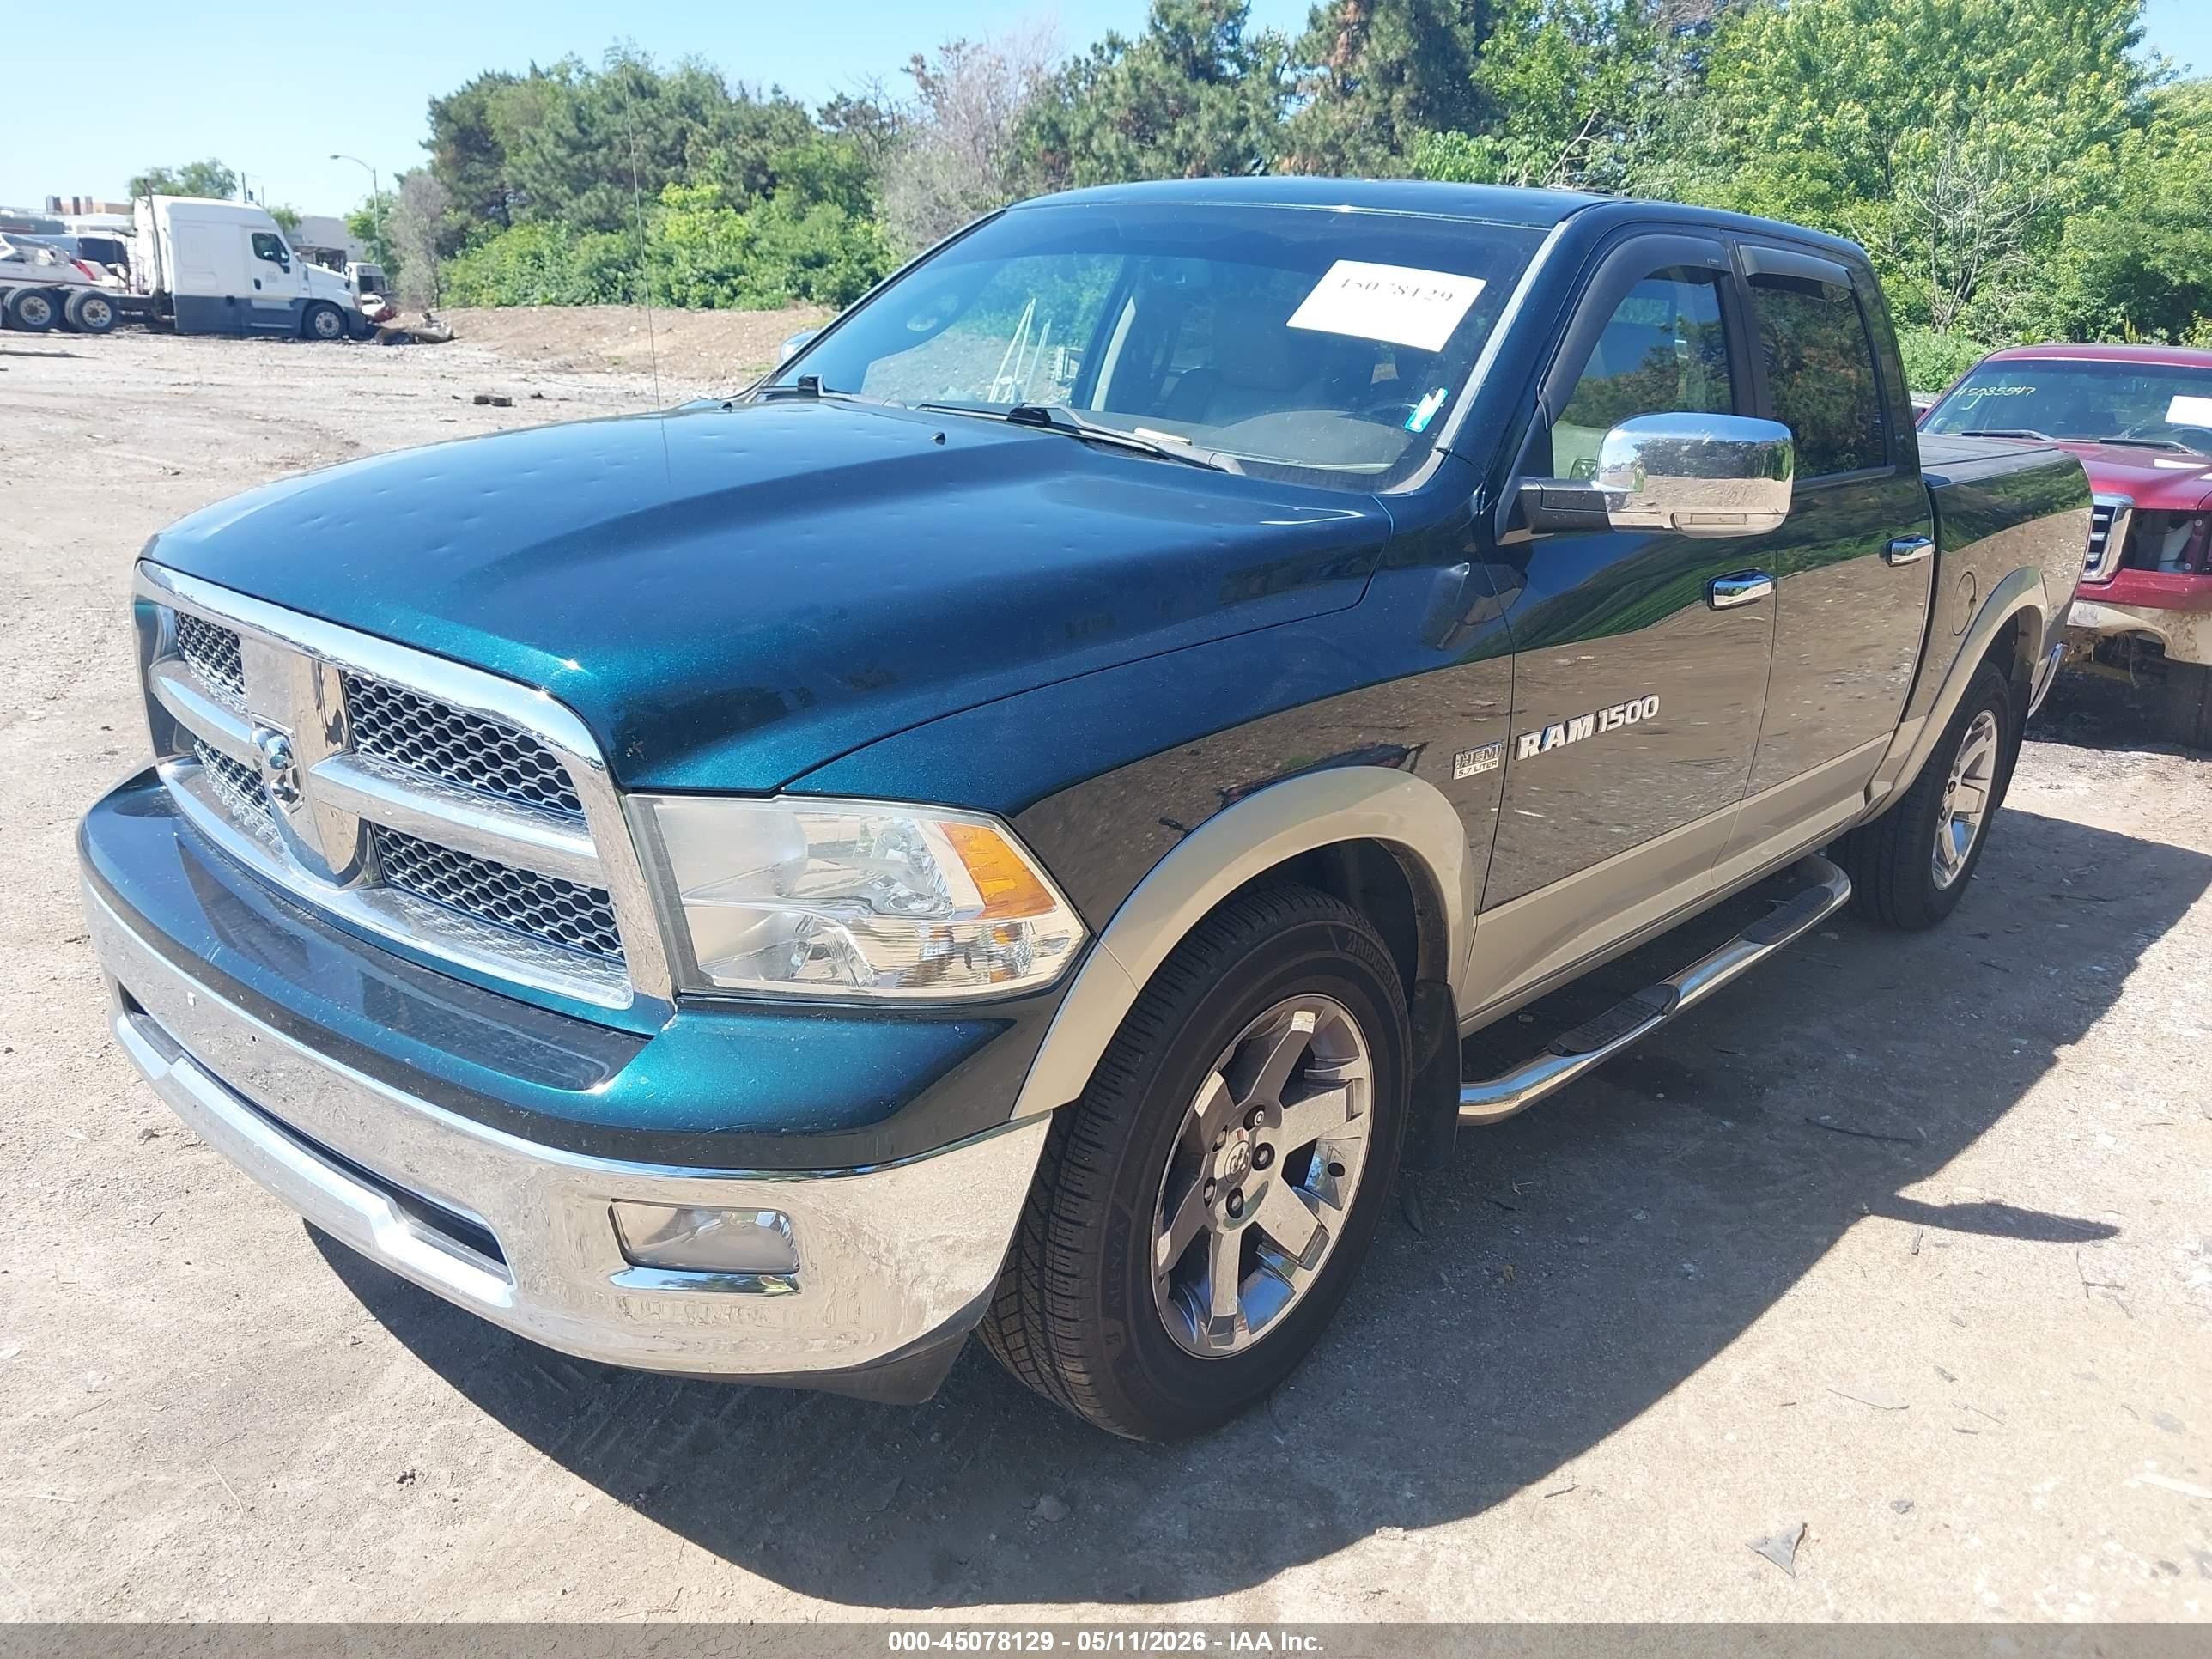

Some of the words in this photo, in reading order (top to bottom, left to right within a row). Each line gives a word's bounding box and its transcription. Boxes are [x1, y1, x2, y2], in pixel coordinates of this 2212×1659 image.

[1516, 713, 1595, 761] RAM
[1596, 694, 1660, 733] 1500
[1459, 744, 1502, 767] HEMI
[1458, 767, 1472, 777] 5.7
[1474, 759, 1498, 772] LITER
